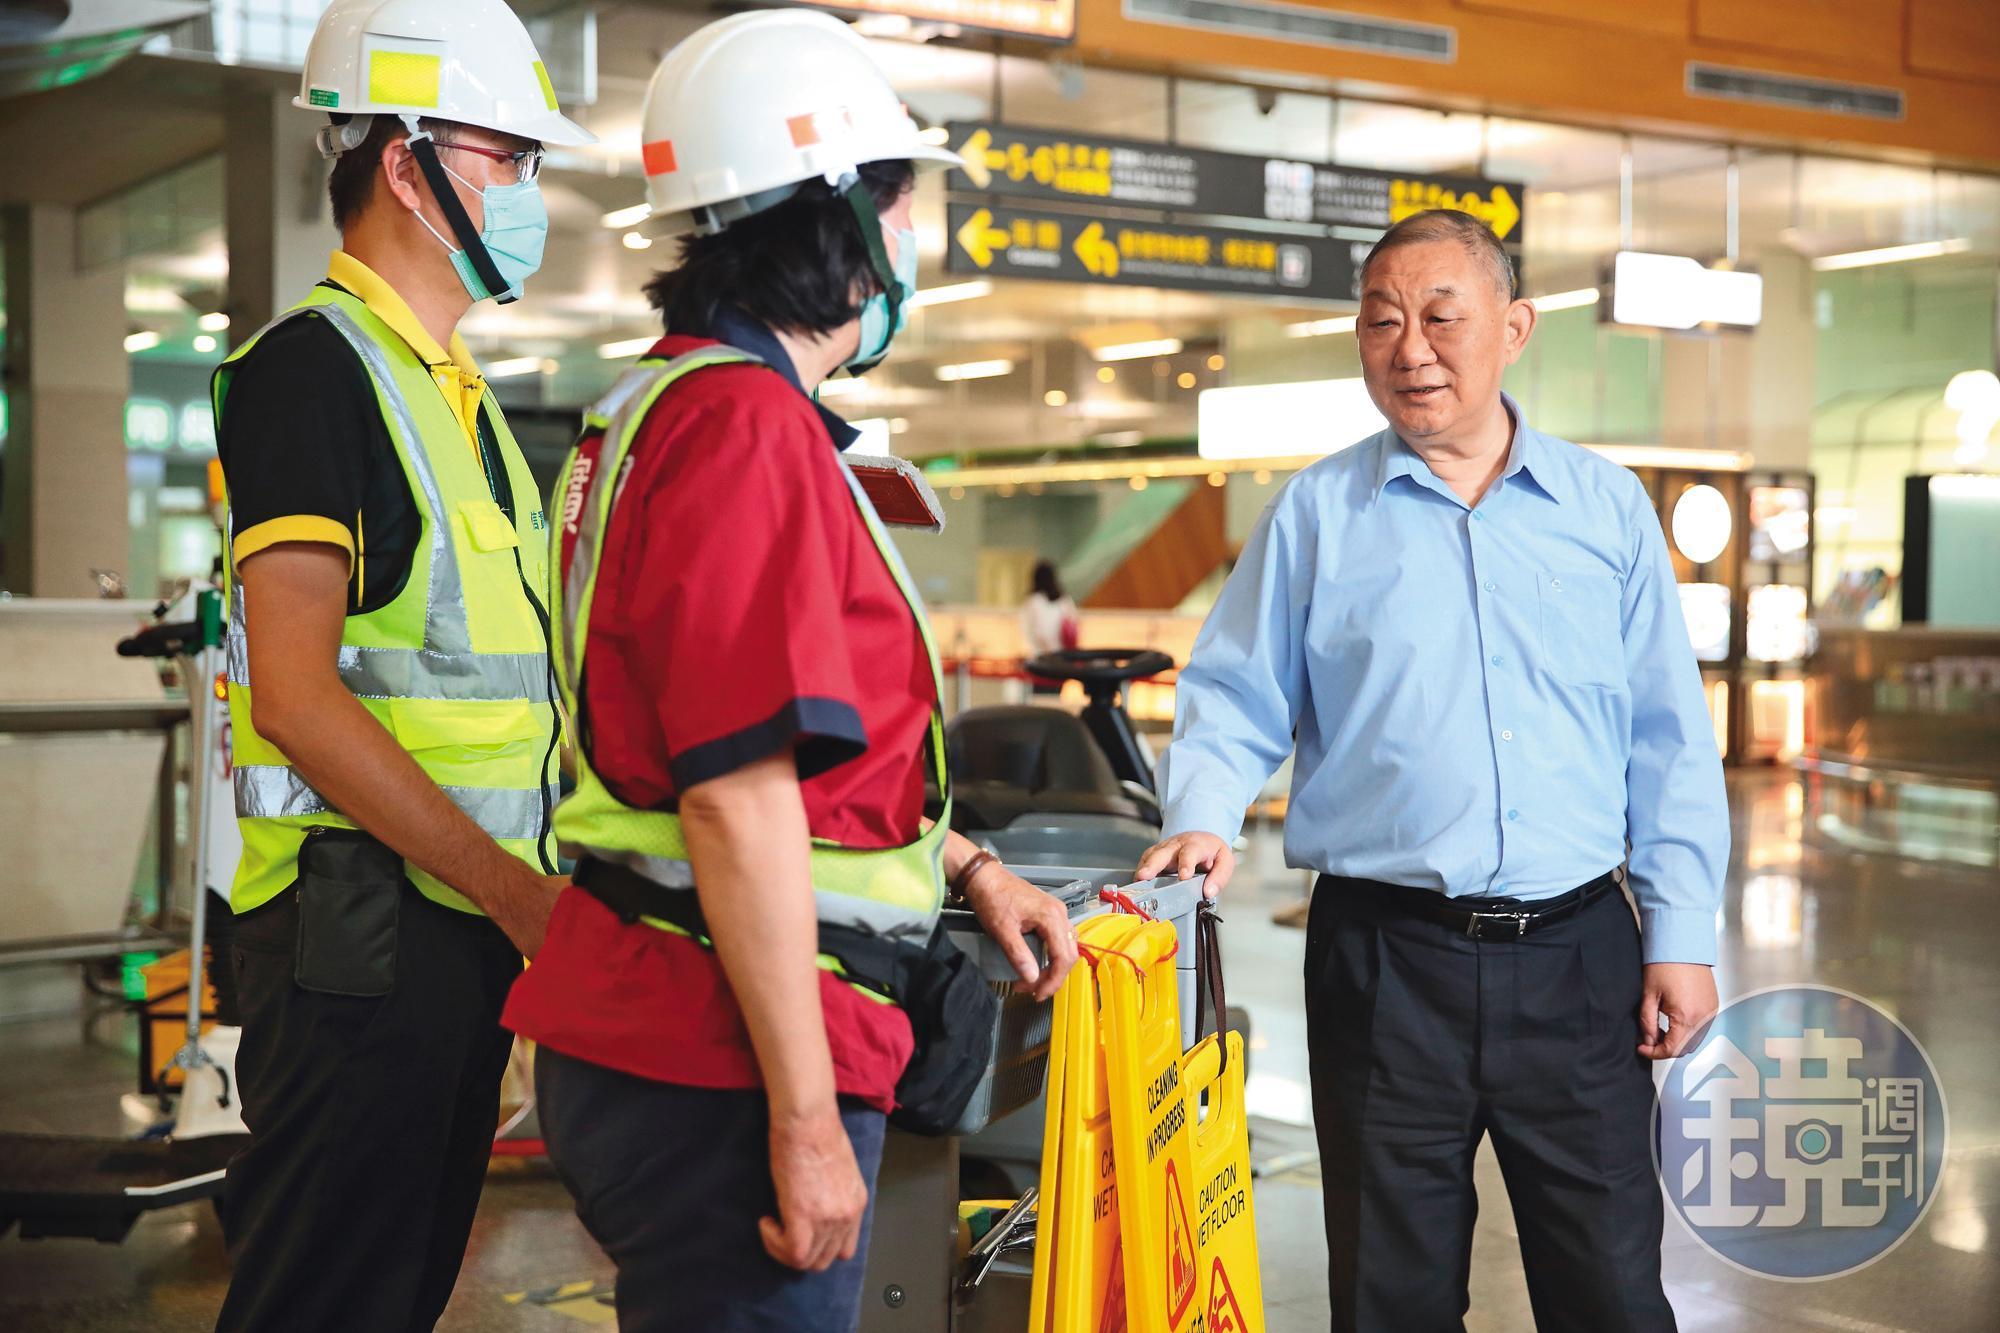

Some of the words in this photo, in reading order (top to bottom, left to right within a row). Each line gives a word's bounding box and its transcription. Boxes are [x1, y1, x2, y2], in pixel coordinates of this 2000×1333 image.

[1147, 1060, 1178, 1114] CLEANING
[1146, 1132, 1155, 1165] IN
[1153, 1098, 1186, 1156] PROGRESS
[1093, 1184, 1115, 1223] WET
[1199, 1161, 1237, 1214] CAUTION
[1211, 1189, 1245, 1236] FLOOR
